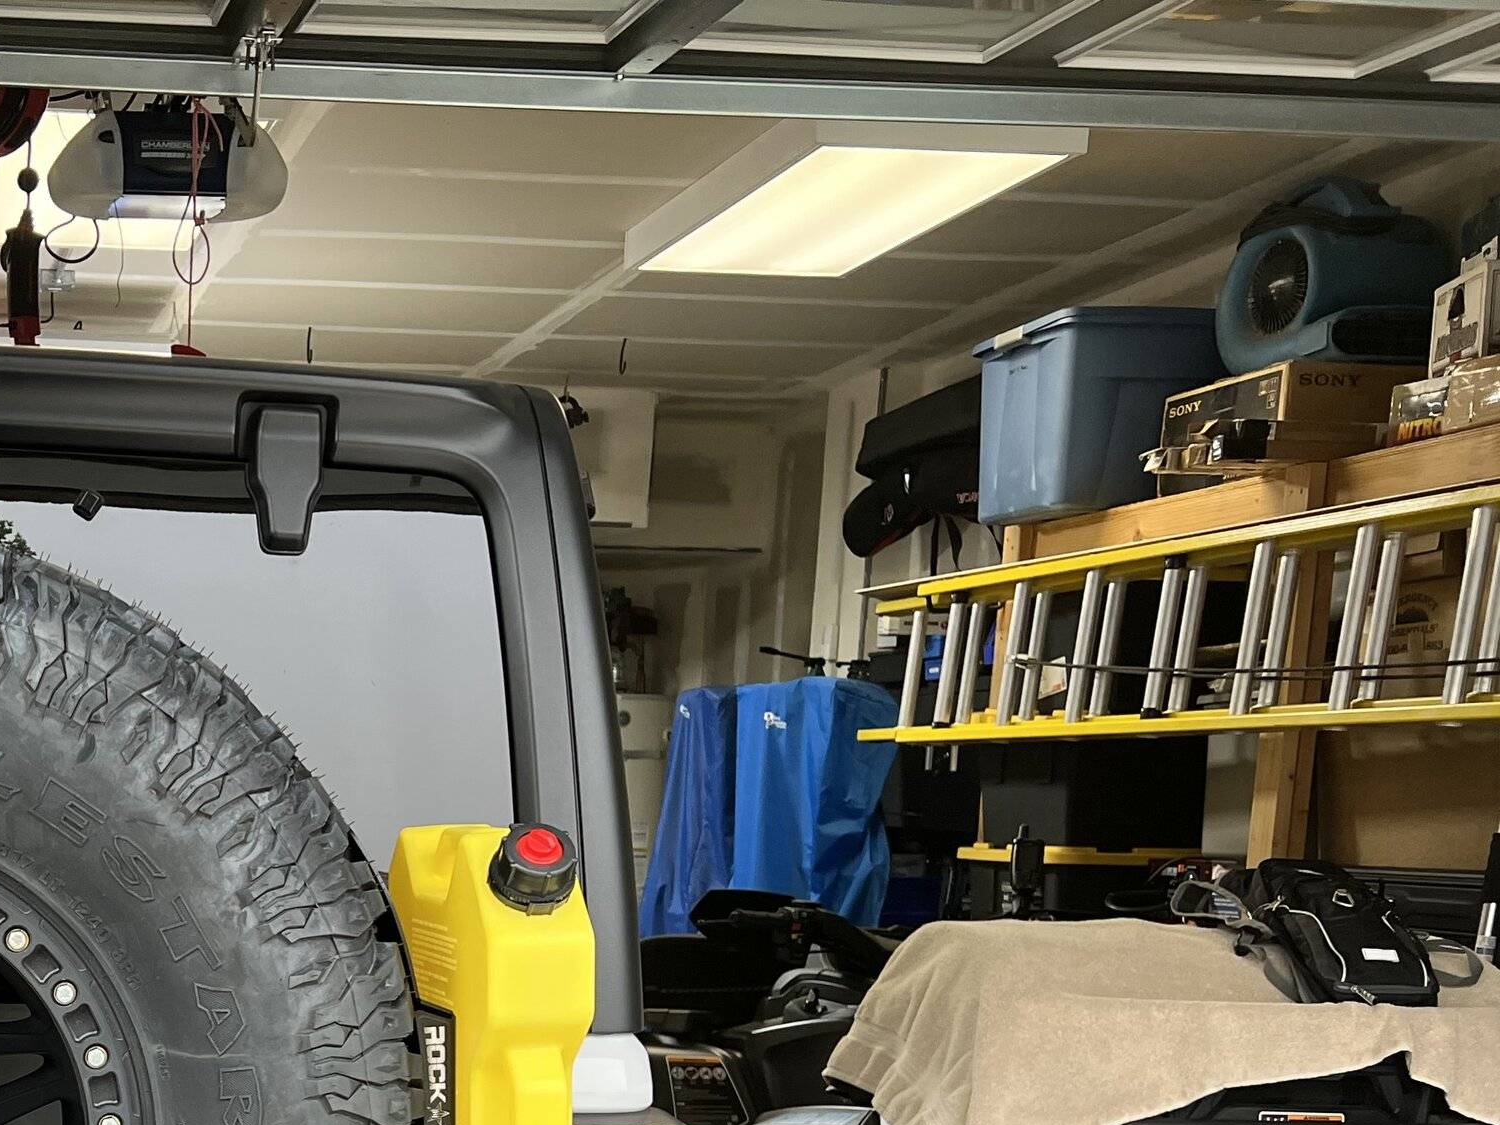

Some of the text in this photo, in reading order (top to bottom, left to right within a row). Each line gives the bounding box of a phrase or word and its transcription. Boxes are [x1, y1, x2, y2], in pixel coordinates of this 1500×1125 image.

[141, 140, 211, 151] CHAMBERLN
[1299, 373, 1361, 387] SONY
[1168, 400, 1202, 419] SONY
[423, 1025, 447, 1103] ROCK
